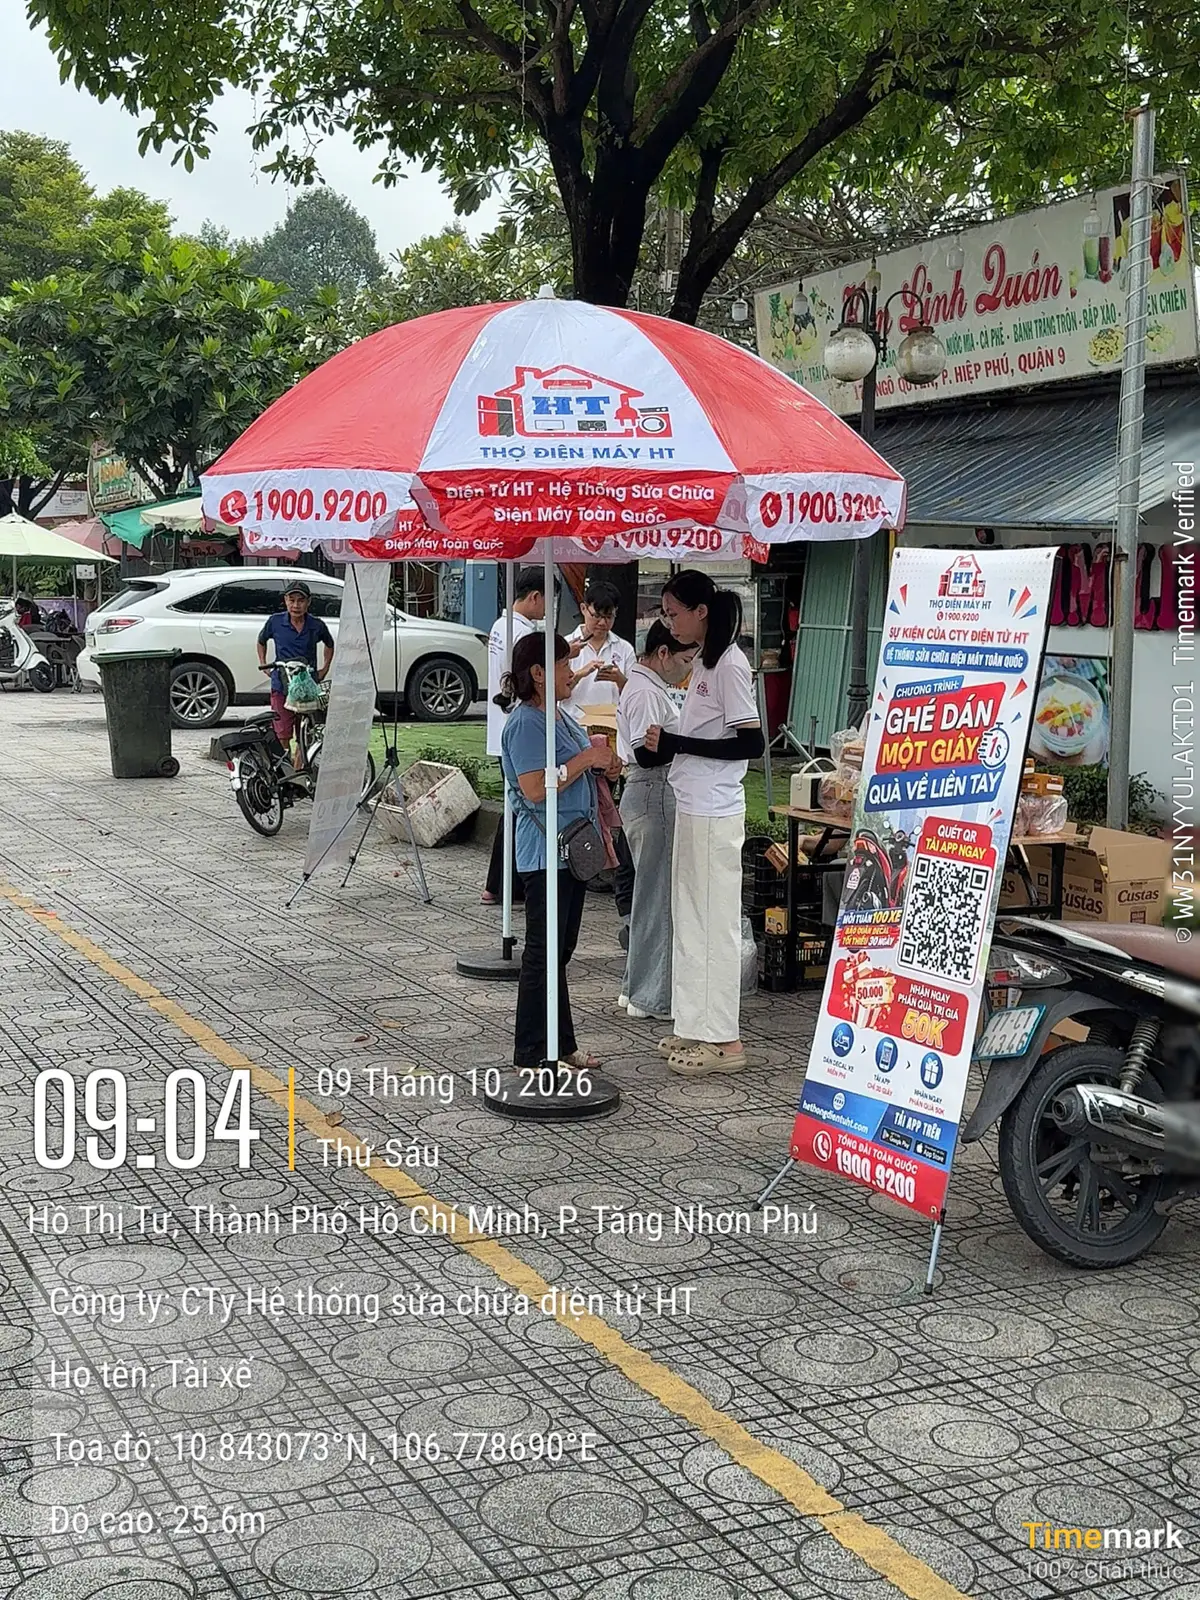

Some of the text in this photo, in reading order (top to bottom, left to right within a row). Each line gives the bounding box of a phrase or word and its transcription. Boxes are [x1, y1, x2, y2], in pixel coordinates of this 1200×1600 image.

[975, 242, 1063, 316] Quán
[1159, 283, 1188, 315] CHIÊN
[941, 368, 953, 386] P.
[954, 355, 983, 385] HIỆP
[984, 351, 1015, 379] PHÚ,
[1018, 346, 1054, 372] QUẬN
[1057, 346, 1066, 366] 9
[532, 396, 611, 416] HT
[479, 443, 676, 462] THỢ ĐIỆN MÁY HT
[445, 478, 716, 501] Điện Tử HT Hệ Thống Sửa Chữa
[252, 488, 388, 522] 1900.9200
[493, 506, 668, 526] Điện Máy Toàn Quốc
[398, 521, 414, 534] HT
[414, 537, 504, 552] Máy Toàn Quốc
[952, 571, 974, 584] HT
[929, 598, 992, 611] THỢ ĐIỆN MÁY HT
[944, 612, 980, 622] 1900.9200
[888, 625, 1030, 645] SỰ KIỆN CỦA CTY ĐIỆN TỬ HT
[914, 646, 930, 662] SỬA
[930, 649, 950, 664] CHỮA
[949, 650, 967, 667] ĐIỆN
[967, 651, 984, 666] MÁY
[984, 652, 1003, 667] TOÀN
[1003, 653, 1024, 669] QUỐC
[896, 684, 932, 697] CHƯƠNG
[886, 694, 994, 735] GHÉ DÁN
[881, 731, 981, 770] MỘT GIÂY
[869, 772, 1002, 805] QUÀ VỀ LIỀN TAY
[937, 824, 978, 843] QUÉT QR
[925, 836, 987, 861] TẢI APP NGAY
[1118, 889, 1159, 903] Custas
[872, 910, 890, 924] 100
[887, 910, 903, 923] XE
[857, 985, 884, 1000] 50.000
[910, 983, 951, 1005] NHẬN NGAY
[916, 999, 933, 1012] QUÀ
[933, 1004, 945, 1018] TRỊ
[945, 1007, 960, 1021] GIÁ
[901, 1008, 948, 1049] 50K
[893, 1110, 942, 1141] TẢI APP TRÊN
[837, 1134, 919, 1176] TỔNG ĐÀI TOÀN QUỐC
[835, 1148, 916, 1204] 1900.9200
